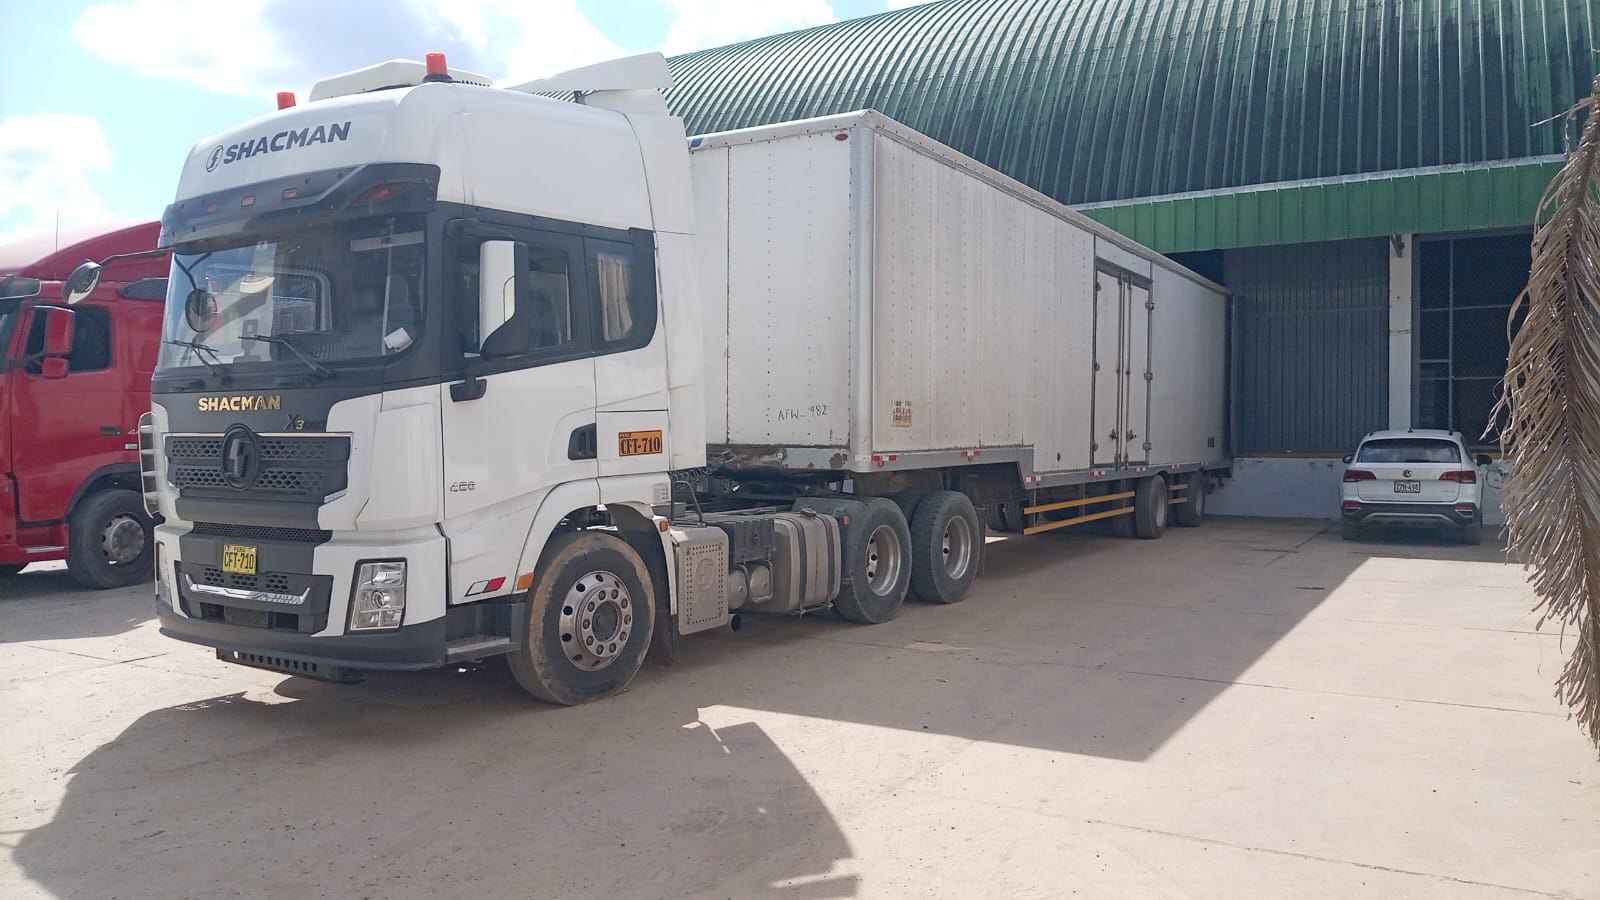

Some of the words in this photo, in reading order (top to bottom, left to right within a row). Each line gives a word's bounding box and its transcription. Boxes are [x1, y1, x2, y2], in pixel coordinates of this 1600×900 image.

[223, 121, 351, 165] SHACMAN
[198, 395, 281, 411] SHACMAN
[620, 437, 661, 454] CFT-710
[224, 551, 255, 570] CFT-710
